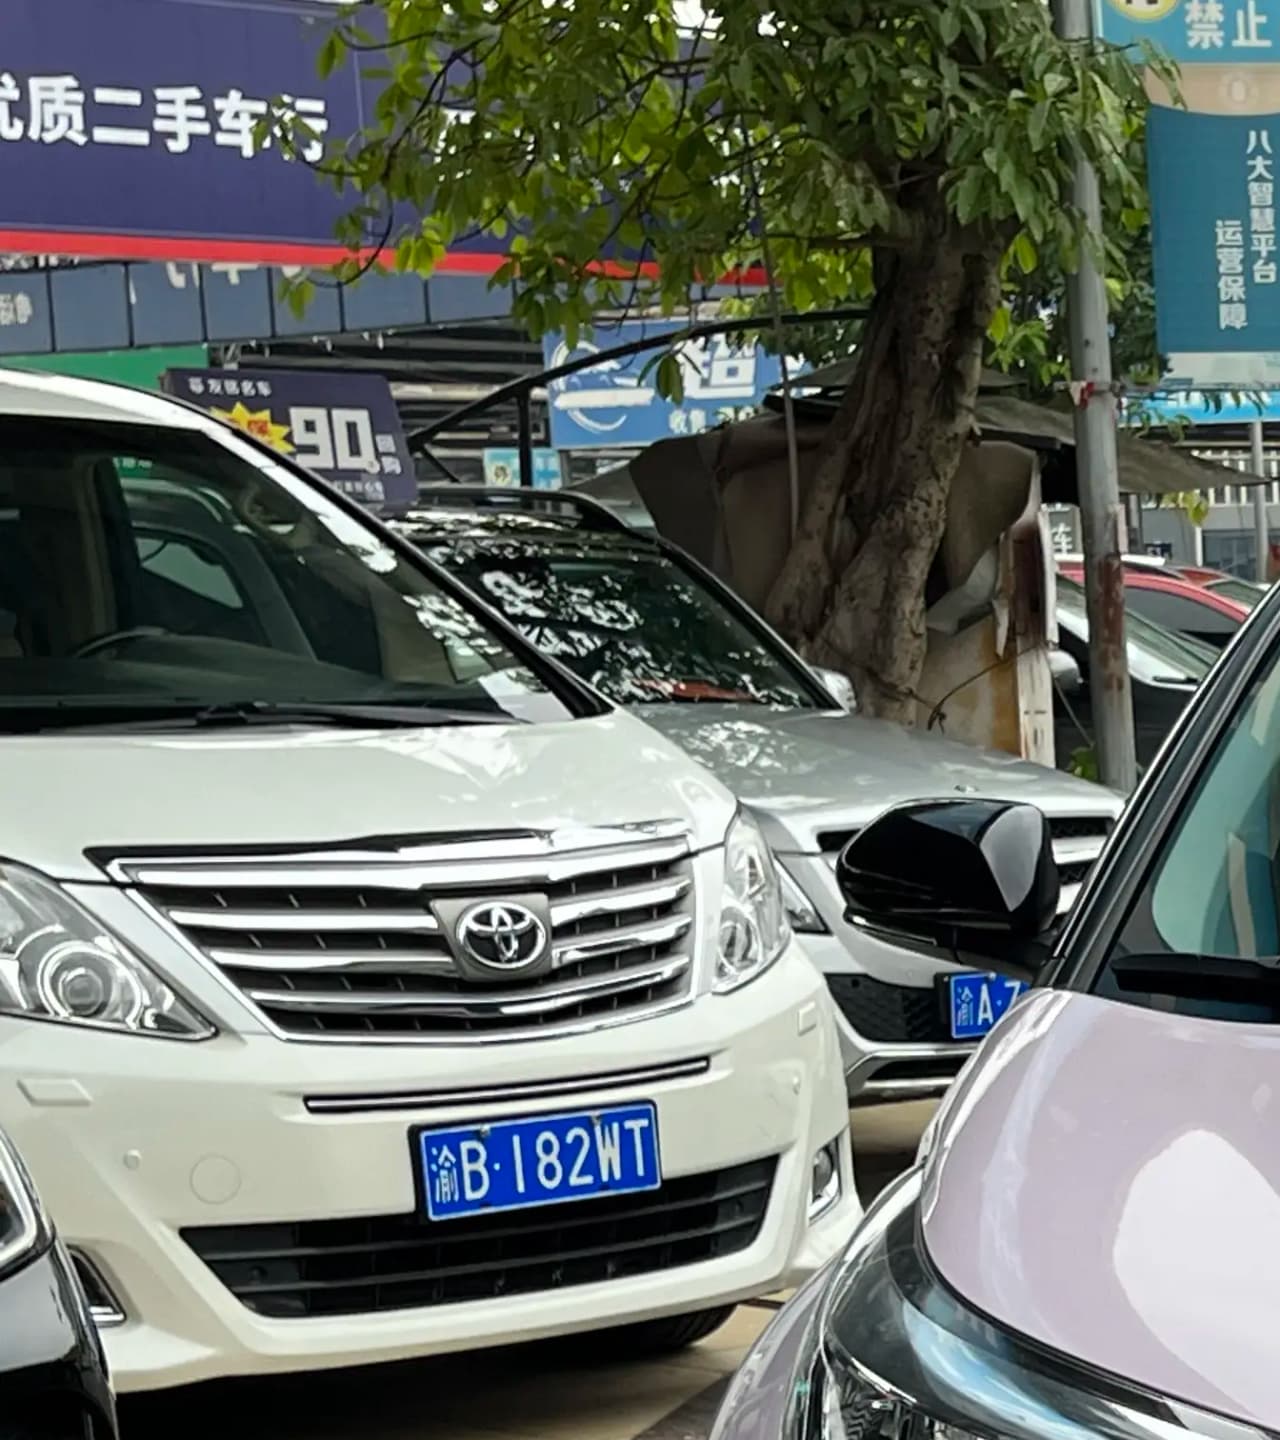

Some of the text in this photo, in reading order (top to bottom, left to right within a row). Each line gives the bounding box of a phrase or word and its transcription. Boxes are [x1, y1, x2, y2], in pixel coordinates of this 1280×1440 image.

[1246, 130, 1278, 285] 八大智慧平台
[1215, 219, 1249, 331] 运营保障
